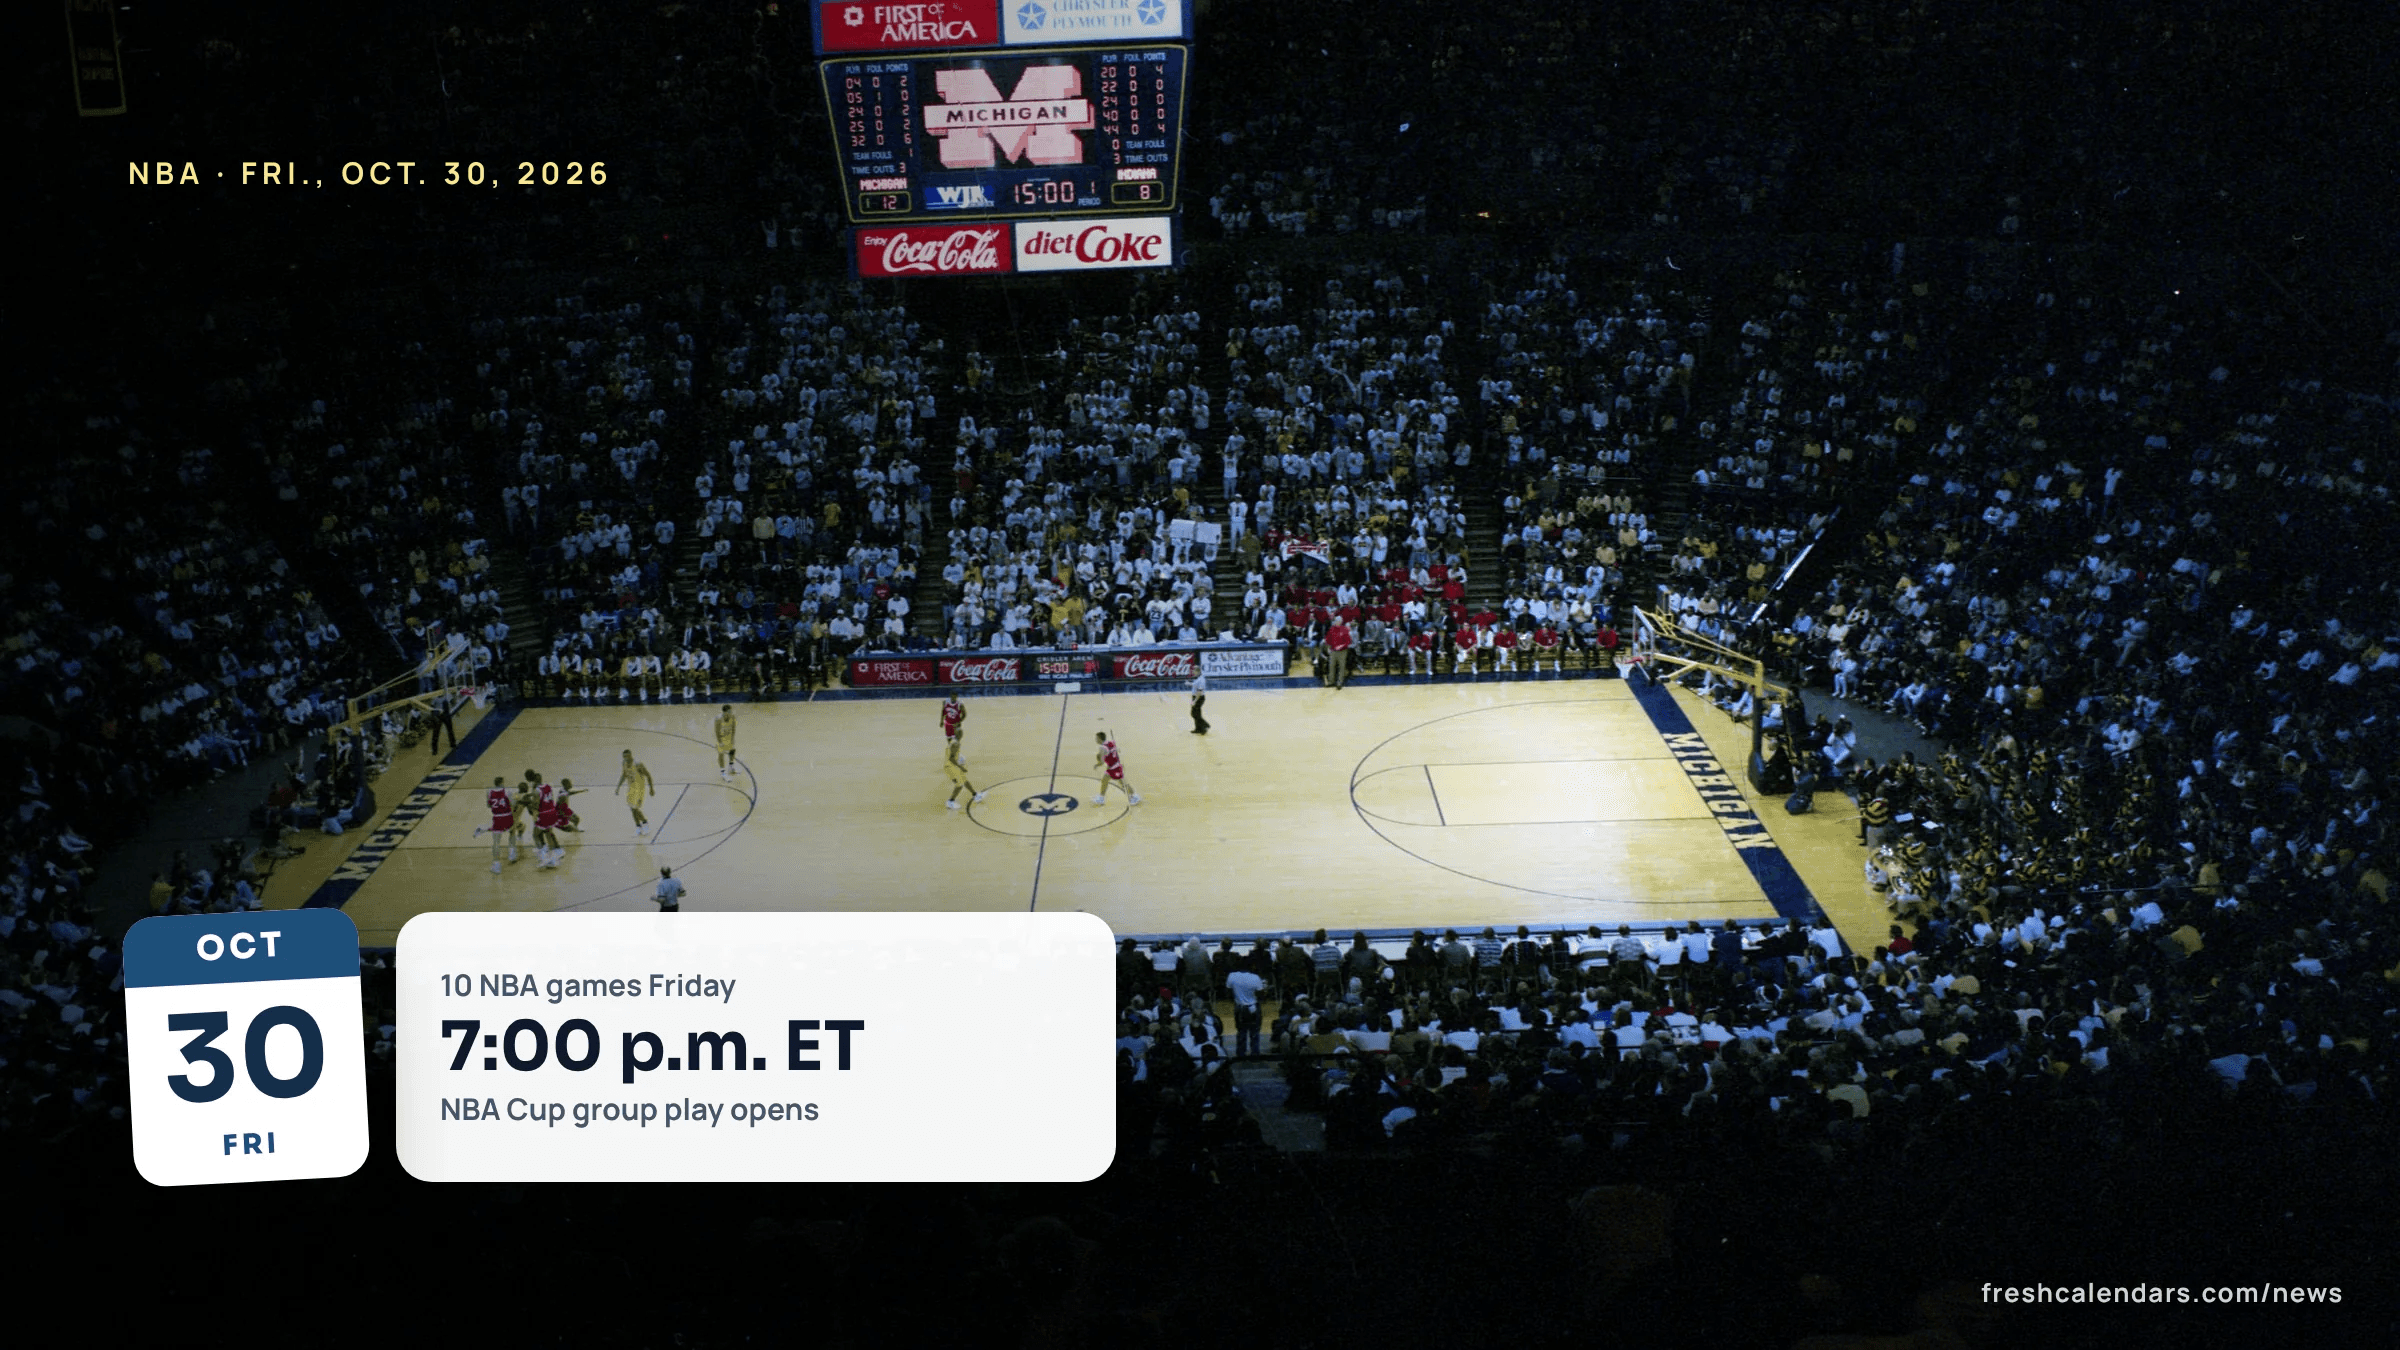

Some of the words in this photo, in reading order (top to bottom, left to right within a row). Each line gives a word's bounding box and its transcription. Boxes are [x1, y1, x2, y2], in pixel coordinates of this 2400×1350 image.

[875, 5, 925, 24] FIRST
[929, 4, 944, 14] OF
[1052, 15, 1132, 29] PLYMOUTH
[881, 21, 977, 41] AMERICA
[1124, 54, 1140, 63] FOUL
[1143, 52, 1166, 61] POINTS
[866, 64, 883, 73] FOUL
[886, 63, 909, 73] POINTS
[1101, 66, 1117, 78] 20
[1129, 65, 1137, 77] 0
[1156, 65, 1164, 75] 4
[846, 77, 862, 89] 04
[872, 76, 880, 88] 0
[900, 75, 908, 87] 2
[1101, 80, 1118, 93] 22
[1129, 80, 1138, 92] 0
[1156, 79, 1164, 91] 0
[847, 91, 864, 104] 05
[901, 89, 909, 102] 0
[1102, 94, 1119, 108] 24
[1130, 94, 1138, 106] 0
[1156, 93, 1165, 105] 0
[848, 106, 864, 118] 24
[874, 105, 882, 117] 0
[902, 104, 910, 116] 2
[946, 105, 1067, 123] MICHIGAN
[1103, 109, 1119, 122] 40
[1131, 109, 1139, 121] 0
[1157, 108, 1165, 120] 0
[849, 120, 865, 132] 25
[875, 119, 884, 131] 0
[904, 118, 911, 130] 2
[1104, 124, 1120, 135] 44
[1131, 123, 1140, 135] 0
[1157, 123, 1166, 133] 4
[851, 135, 866, 147] 32
[876, 134, 884, 146] 0
[1112, 139, 1121, 150] 0
[1126, 141, 1143, 150] TEAM
[1145, 140, 1165, 149] FOULS
[852, 152, 870, 161] TEAM
[872, 151, 893, 160] FOULS
[1114, 153, 1121, 165] 3
[1125, 154, 1144, 163] TIME
[1146, 154, 1169, 162] OUTS
[852, 166, 870, 175] TIME
[873, 165, 896, 174] OUTS
[899, 161, 906, 173] 3
[1117, 167, 1158, 181] INDIANA
[859, 177, 908, 191] MICHIGAN
[936, 186, 990, 208] WJR
[1014, 181, 1075, 205] 15:00
[1139, 184, 1150, 200] 8
[882, 195, 897, 210] 12
[1078, 197, 1101, 206] PERIOD
[864, 236, 888, 246] Enjoy
[883, 229, 1000, 272] Coca-Cola
[1024, 231, 1074, 254] diet
[1075, 225, 1162, 262] Coke
[874, 662, 901, 673] FIRST
[951, 658, 1019, 682] Coca-Cola
[1040, 662, 1069, 674] 15:00
[1124, 653, 1194, 677] Coca-Cola
[878, 671, 928, 682] AMERICA
[1661, 732, 1778, 849] MICHIGAN
[492, 797, 507, 809] 24
[1026, 797, 1072, 813] M
[327, 764, 472, 881] MICHIGAN
